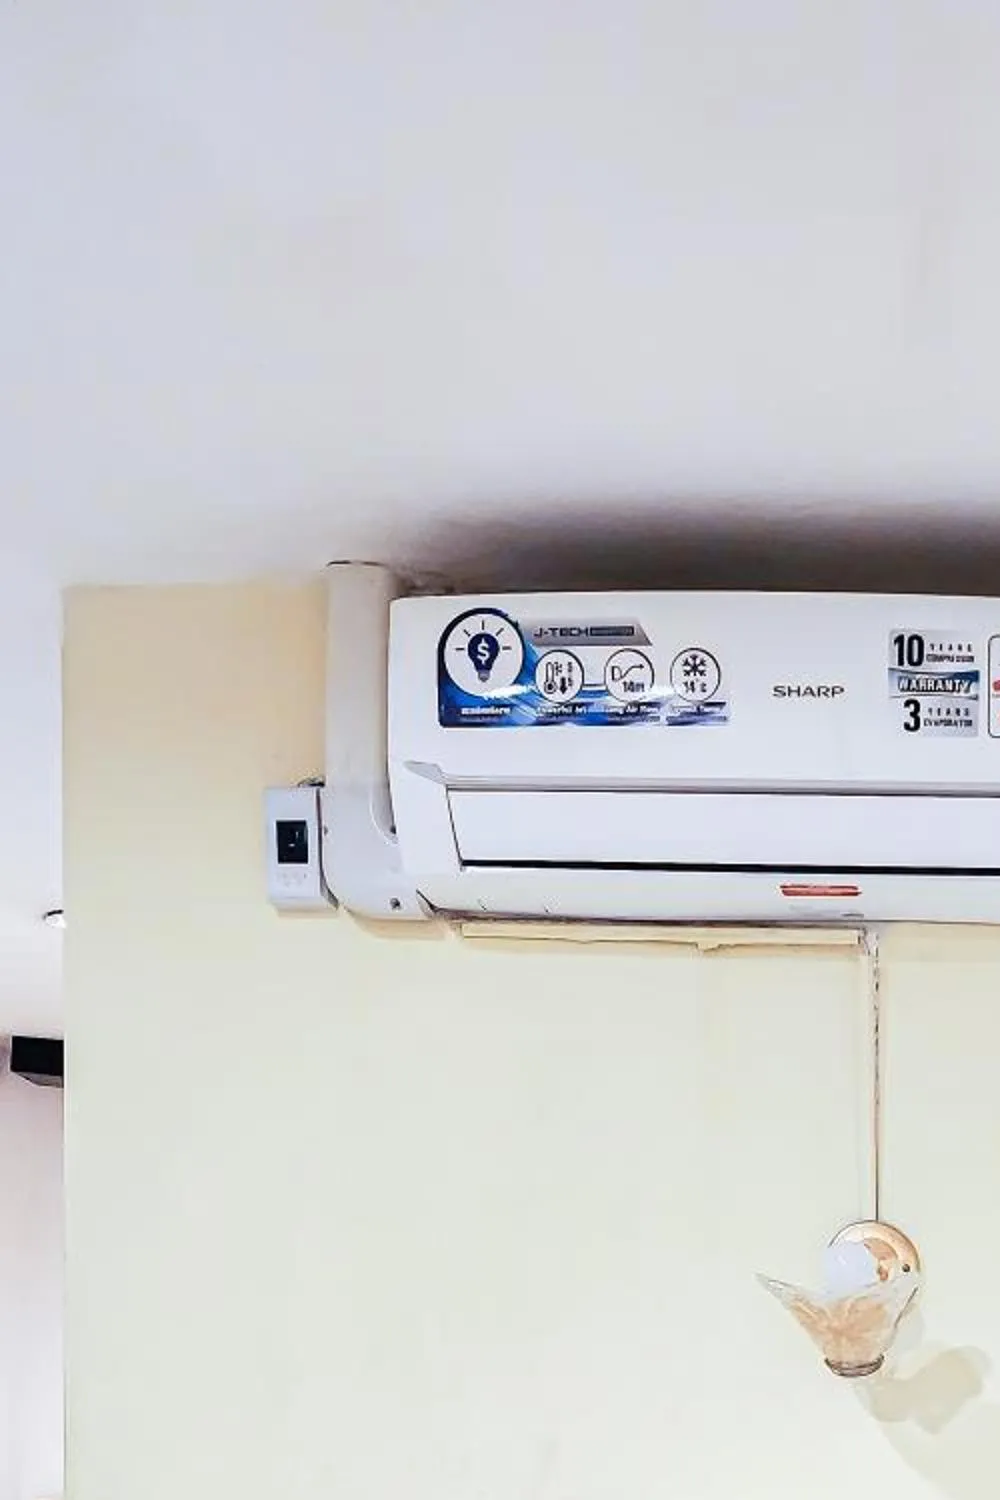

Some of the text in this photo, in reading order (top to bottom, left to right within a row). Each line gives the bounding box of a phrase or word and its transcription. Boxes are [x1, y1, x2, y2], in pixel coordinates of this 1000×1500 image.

[893, 633, 925, 667] 10
[772, 684, 845, 698] SHARP
[898, 676, 972, 694] WARRANTY
[903, 698, 921, 732] 3
